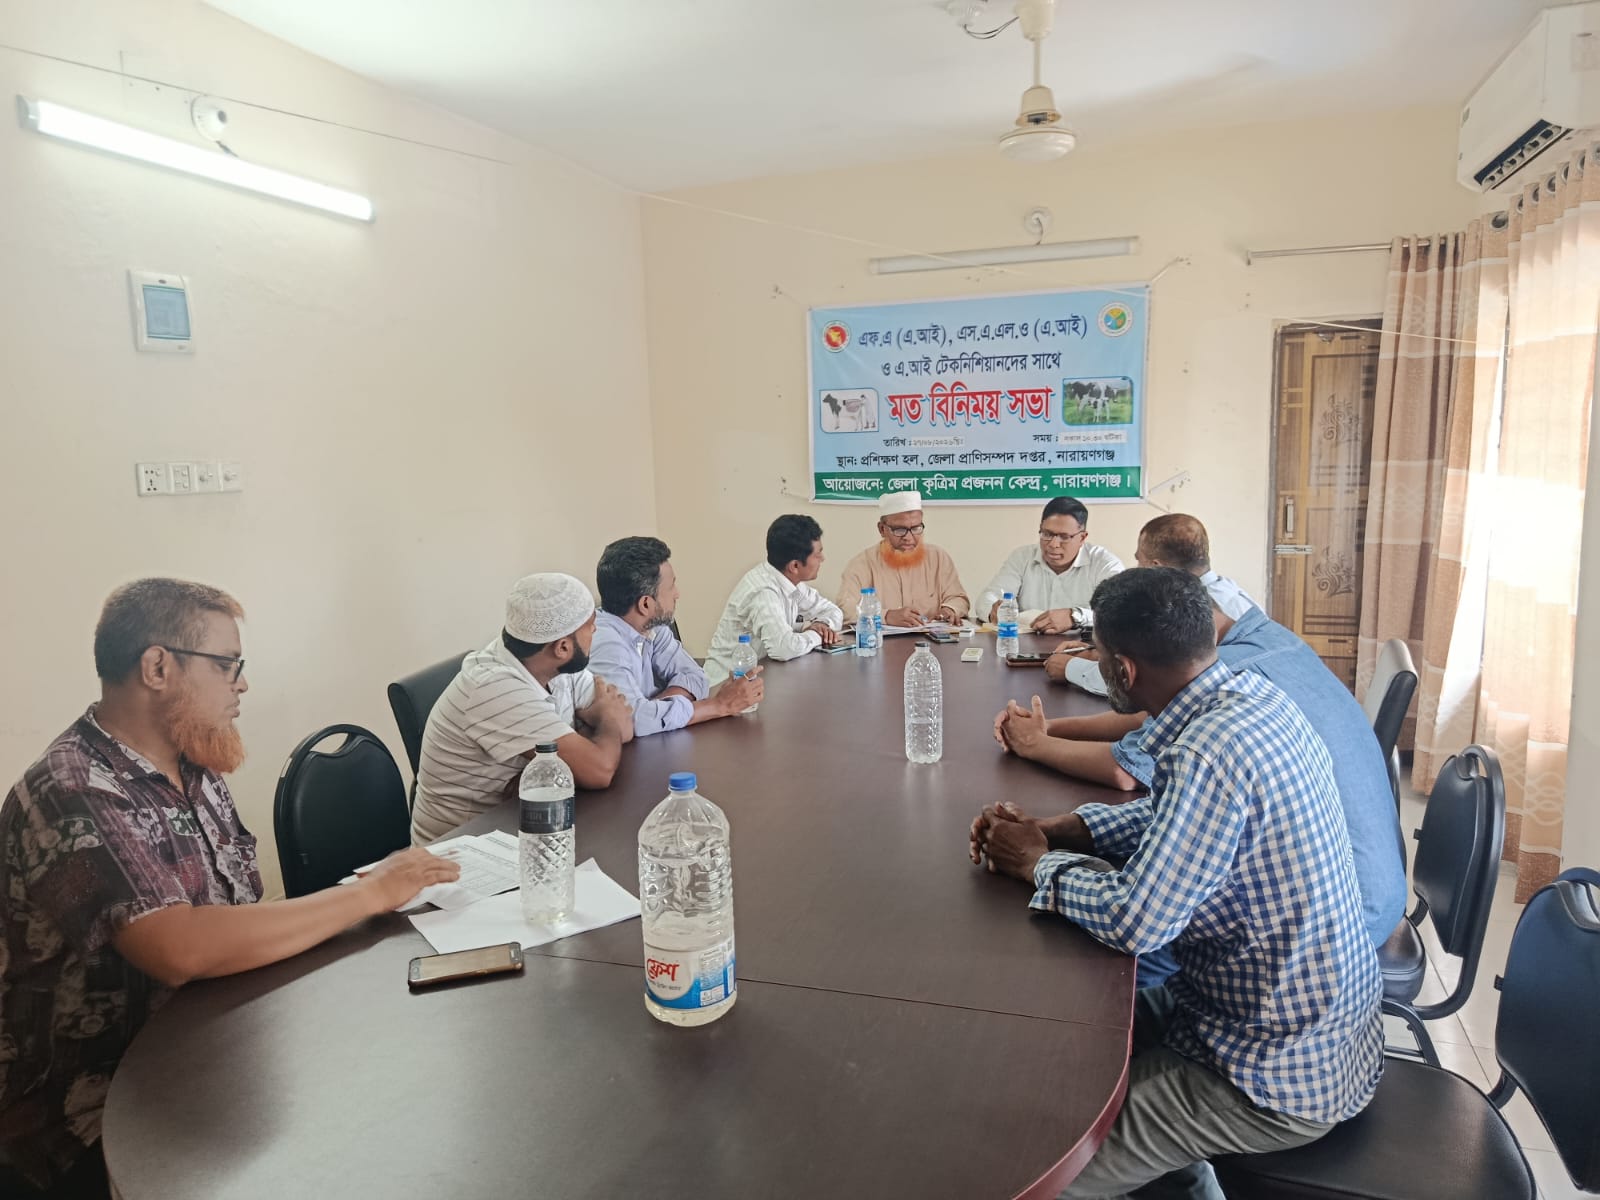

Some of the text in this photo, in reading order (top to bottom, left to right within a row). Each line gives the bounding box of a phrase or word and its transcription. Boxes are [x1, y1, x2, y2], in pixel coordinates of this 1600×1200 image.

[859, 331, 892, 347] এফ.এ
[957, 321, 1029, 343] এস.এ.এল.ও
[1034, 314, 1088, 342] (এ.আই)
[881, 351, 1062, 377] ও এ.আই টেকনিশিয়ানদের সাথে
[887, 381, 1053, 425] মত বিনিময় সভা
[1033, 433, 1052, 443] সময়
[860, 453, 899, 468] প্রশিক্ষণ
[928, 453, 957, 466] জেলা
[959, 449, 1014, 466] প্রাণিসম্পদ
[1056, 448, 1115, 463] নারায়ণগঞ্জ
[887, 476, 918, 491] জেলা
[921, 474, 957, 494] কৃত্রিম
[961, 475, 1004, 492] প্রজনন
[1052, 473, 1122, 489] নারায়ণগঞ্জ
